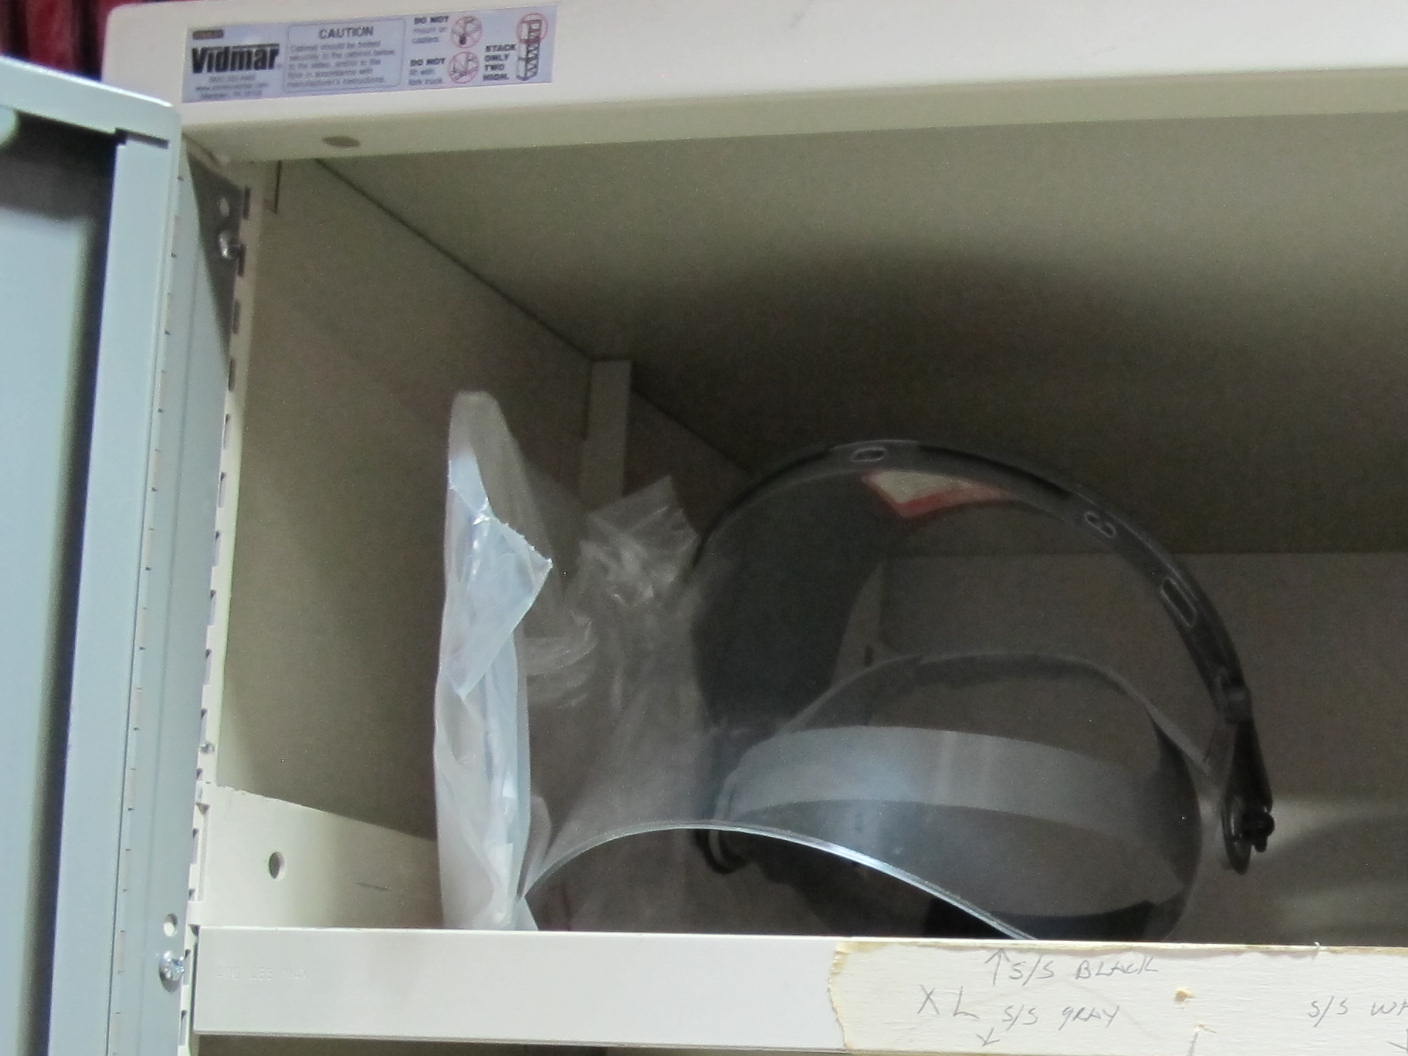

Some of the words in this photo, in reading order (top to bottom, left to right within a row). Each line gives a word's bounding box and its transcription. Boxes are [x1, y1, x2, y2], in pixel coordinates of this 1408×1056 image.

[414, 17, 427, 25] DO
[430, 15, 449, 23] NOT
[318, 26, 374, 39] CAUTION
[485, 44, 517, 52] STACK
[192, 44, 280, 73] Vidmar
[410, 59, 424, 67] DO
[426, 58, 446, 66] NOT
[484, 54, 509, 62] ONLY
[1008, 956, 1056, 986] S/S
[1074, 955, 1159, 981] BLACK
[1307, 994, 1349, 1028] S/S
[1002, 1005, 1039, 1032] S/S
